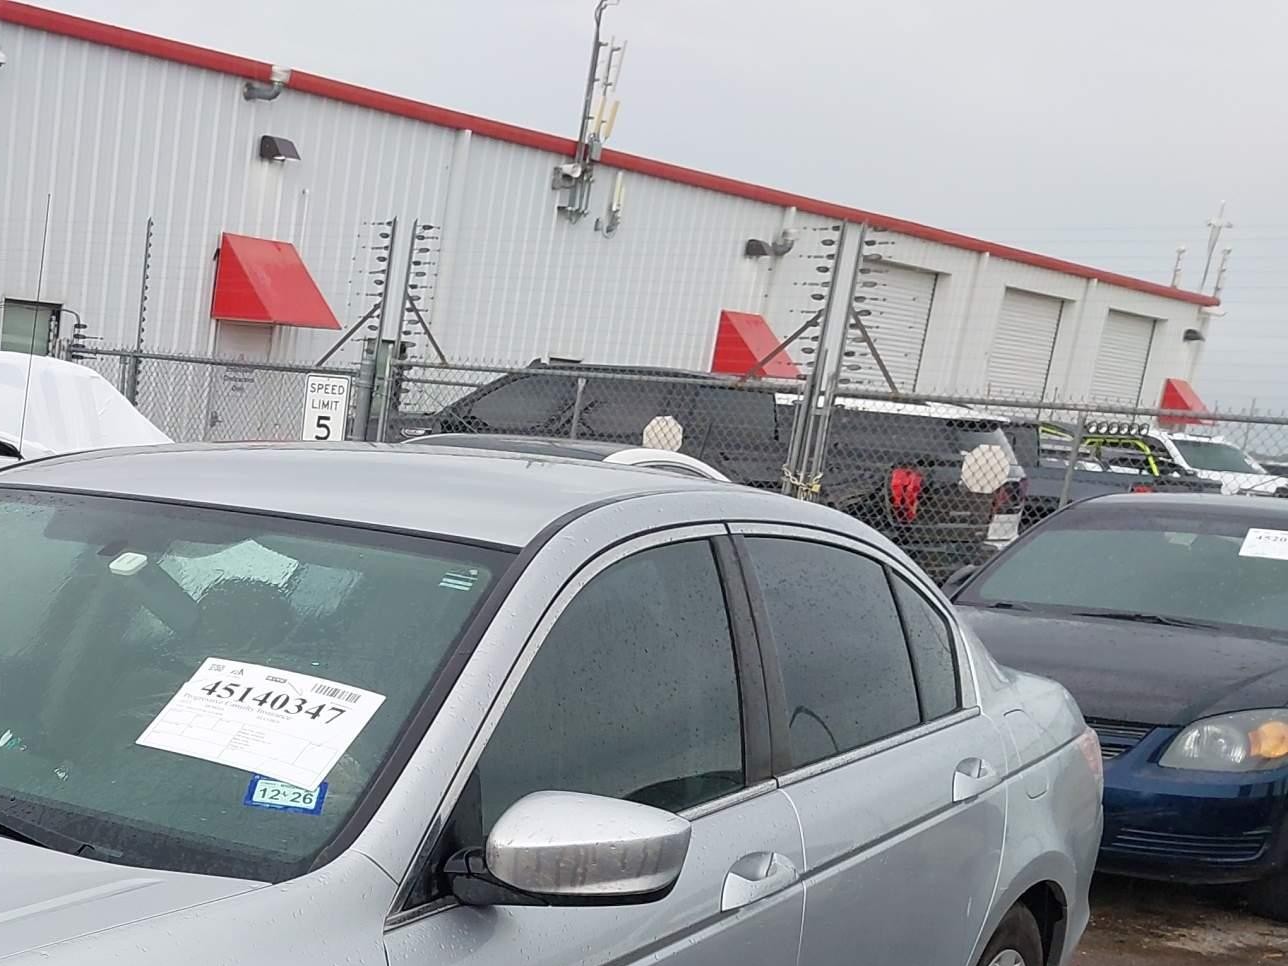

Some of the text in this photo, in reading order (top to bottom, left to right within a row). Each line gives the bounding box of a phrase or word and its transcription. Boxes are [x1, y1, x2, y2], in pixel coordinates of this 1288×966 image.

[309, 382, 345, 396] SPEED
[311, 400, 340, 411] LIMIT
[314, 415, 331, 441] 5
[200, 680, 347, 724] 45140347
[259, 787, 314, 804] 12 26
